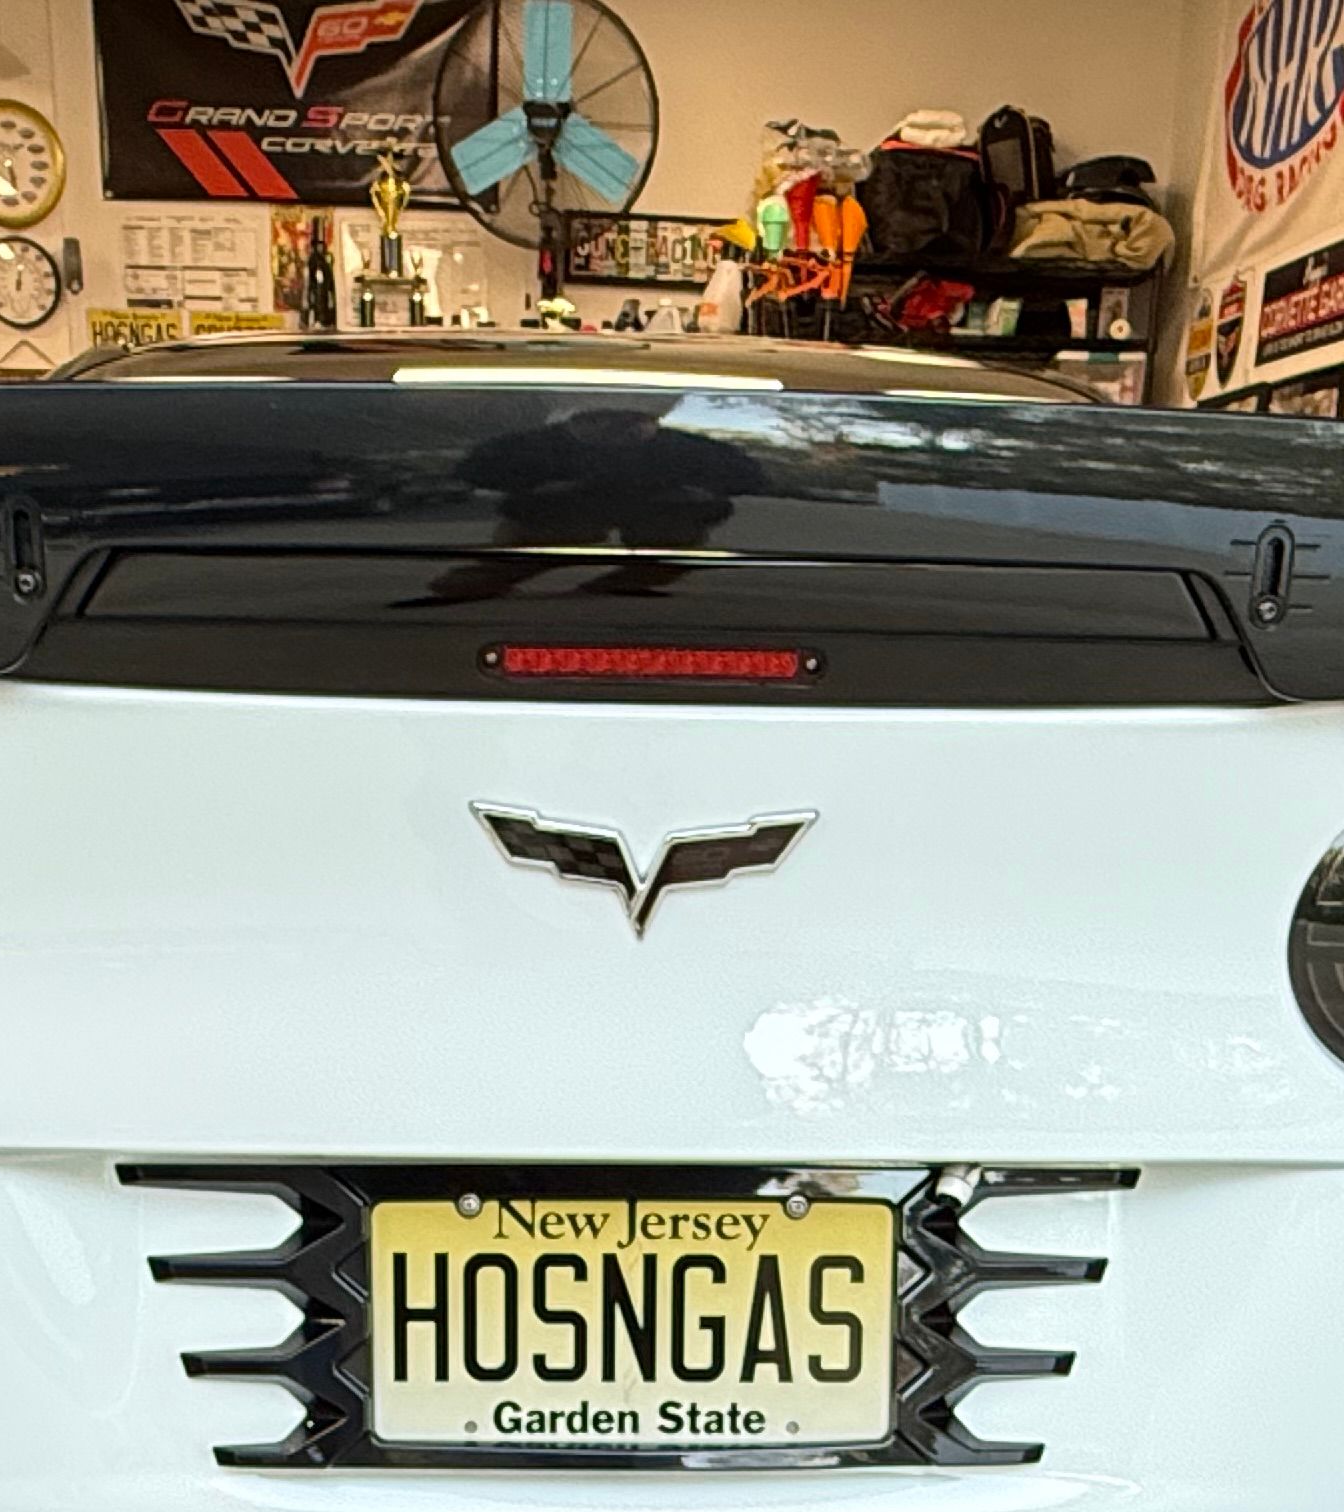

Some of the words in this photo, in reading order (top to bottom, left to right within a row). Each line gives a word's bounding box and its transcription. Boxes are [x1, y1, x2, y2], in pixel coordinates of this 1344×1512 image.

[147, 100, 297, 127] GRAND
[493, 1199, 610, 1240] New
[617, 1199, 771, 1251] Jersey
[392, 1252, 865, 1384] HOSNGAS
[493, 1401, 640, 1436] Garden
[657, 1401, 766, 1436] State
